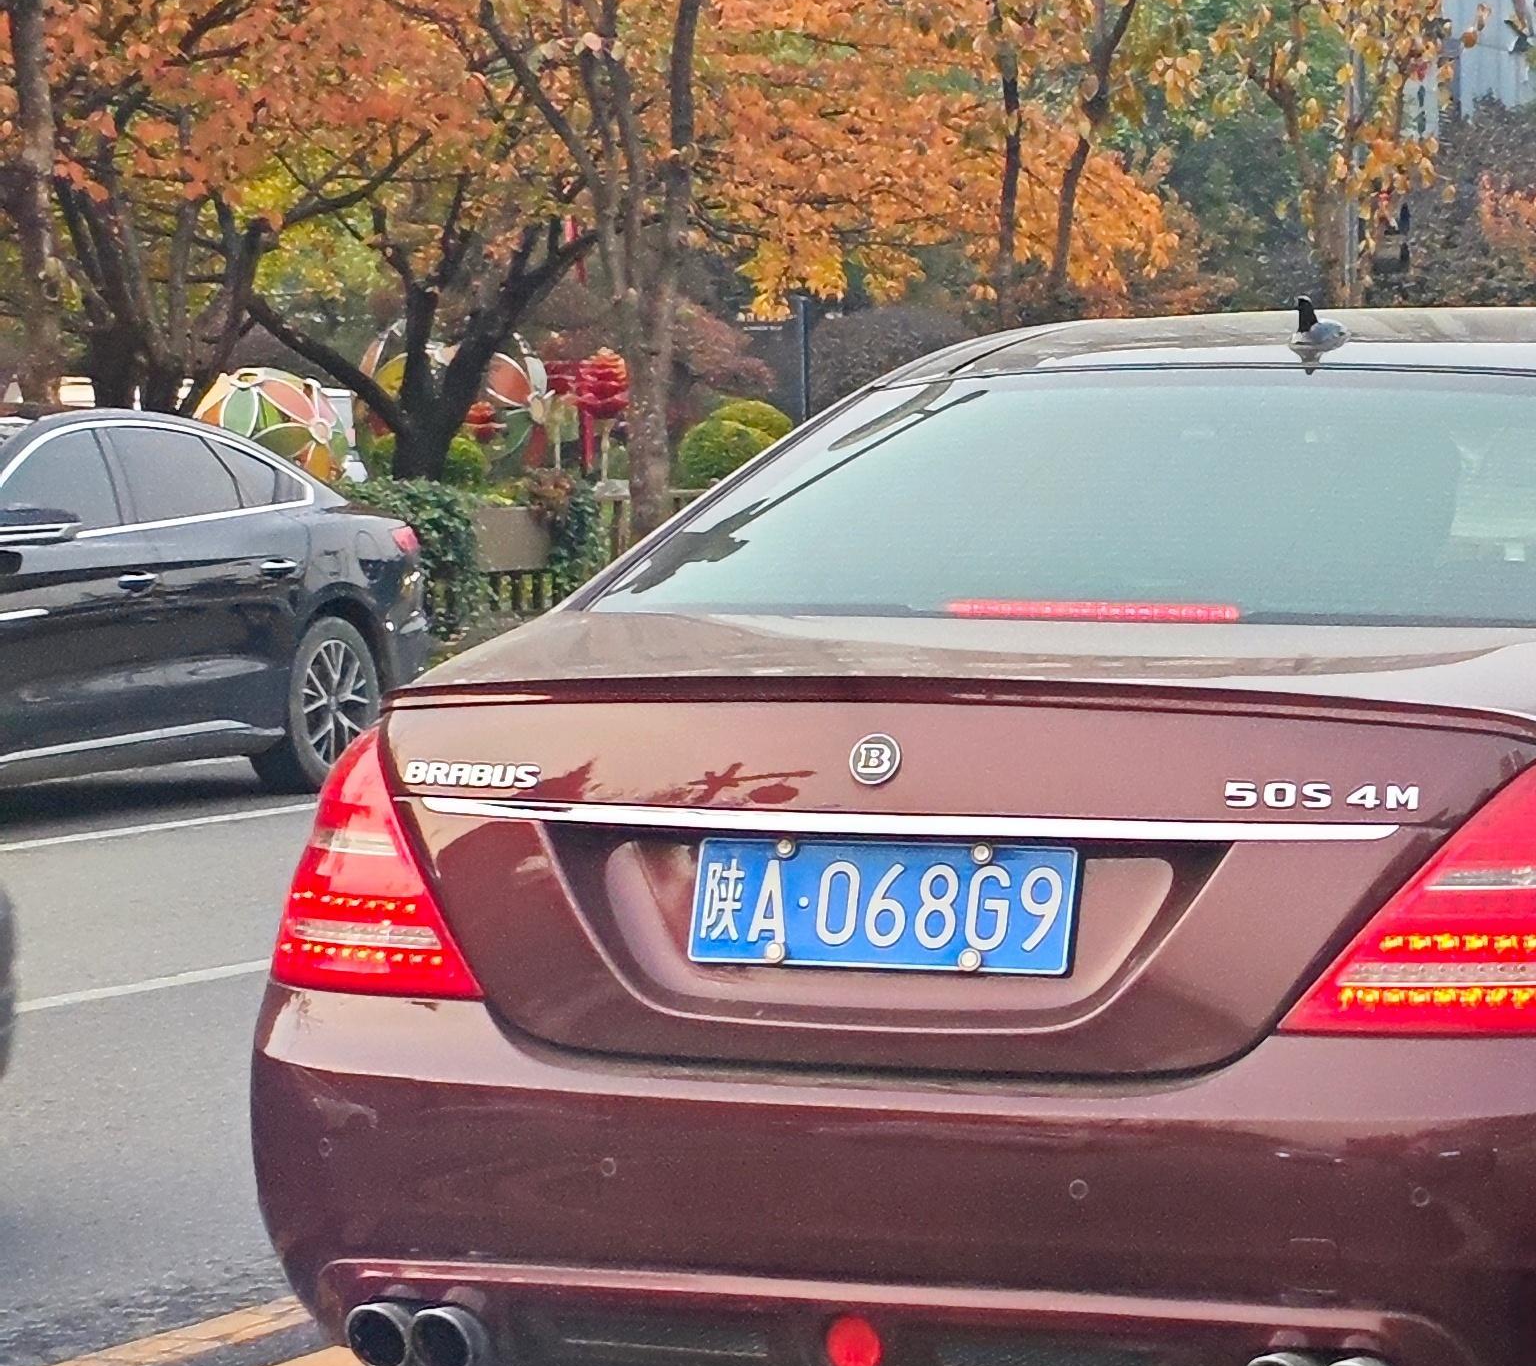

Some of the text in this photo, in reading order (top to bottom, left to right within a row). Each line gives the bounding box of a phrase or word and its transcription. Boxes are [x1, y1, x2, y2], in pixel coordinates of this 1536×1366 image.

[402, 760, 542, 789] BRABUS
[1346, 783, 1420, 811] 4M
[700, 858, 1064, 952] 陕A·068G9
